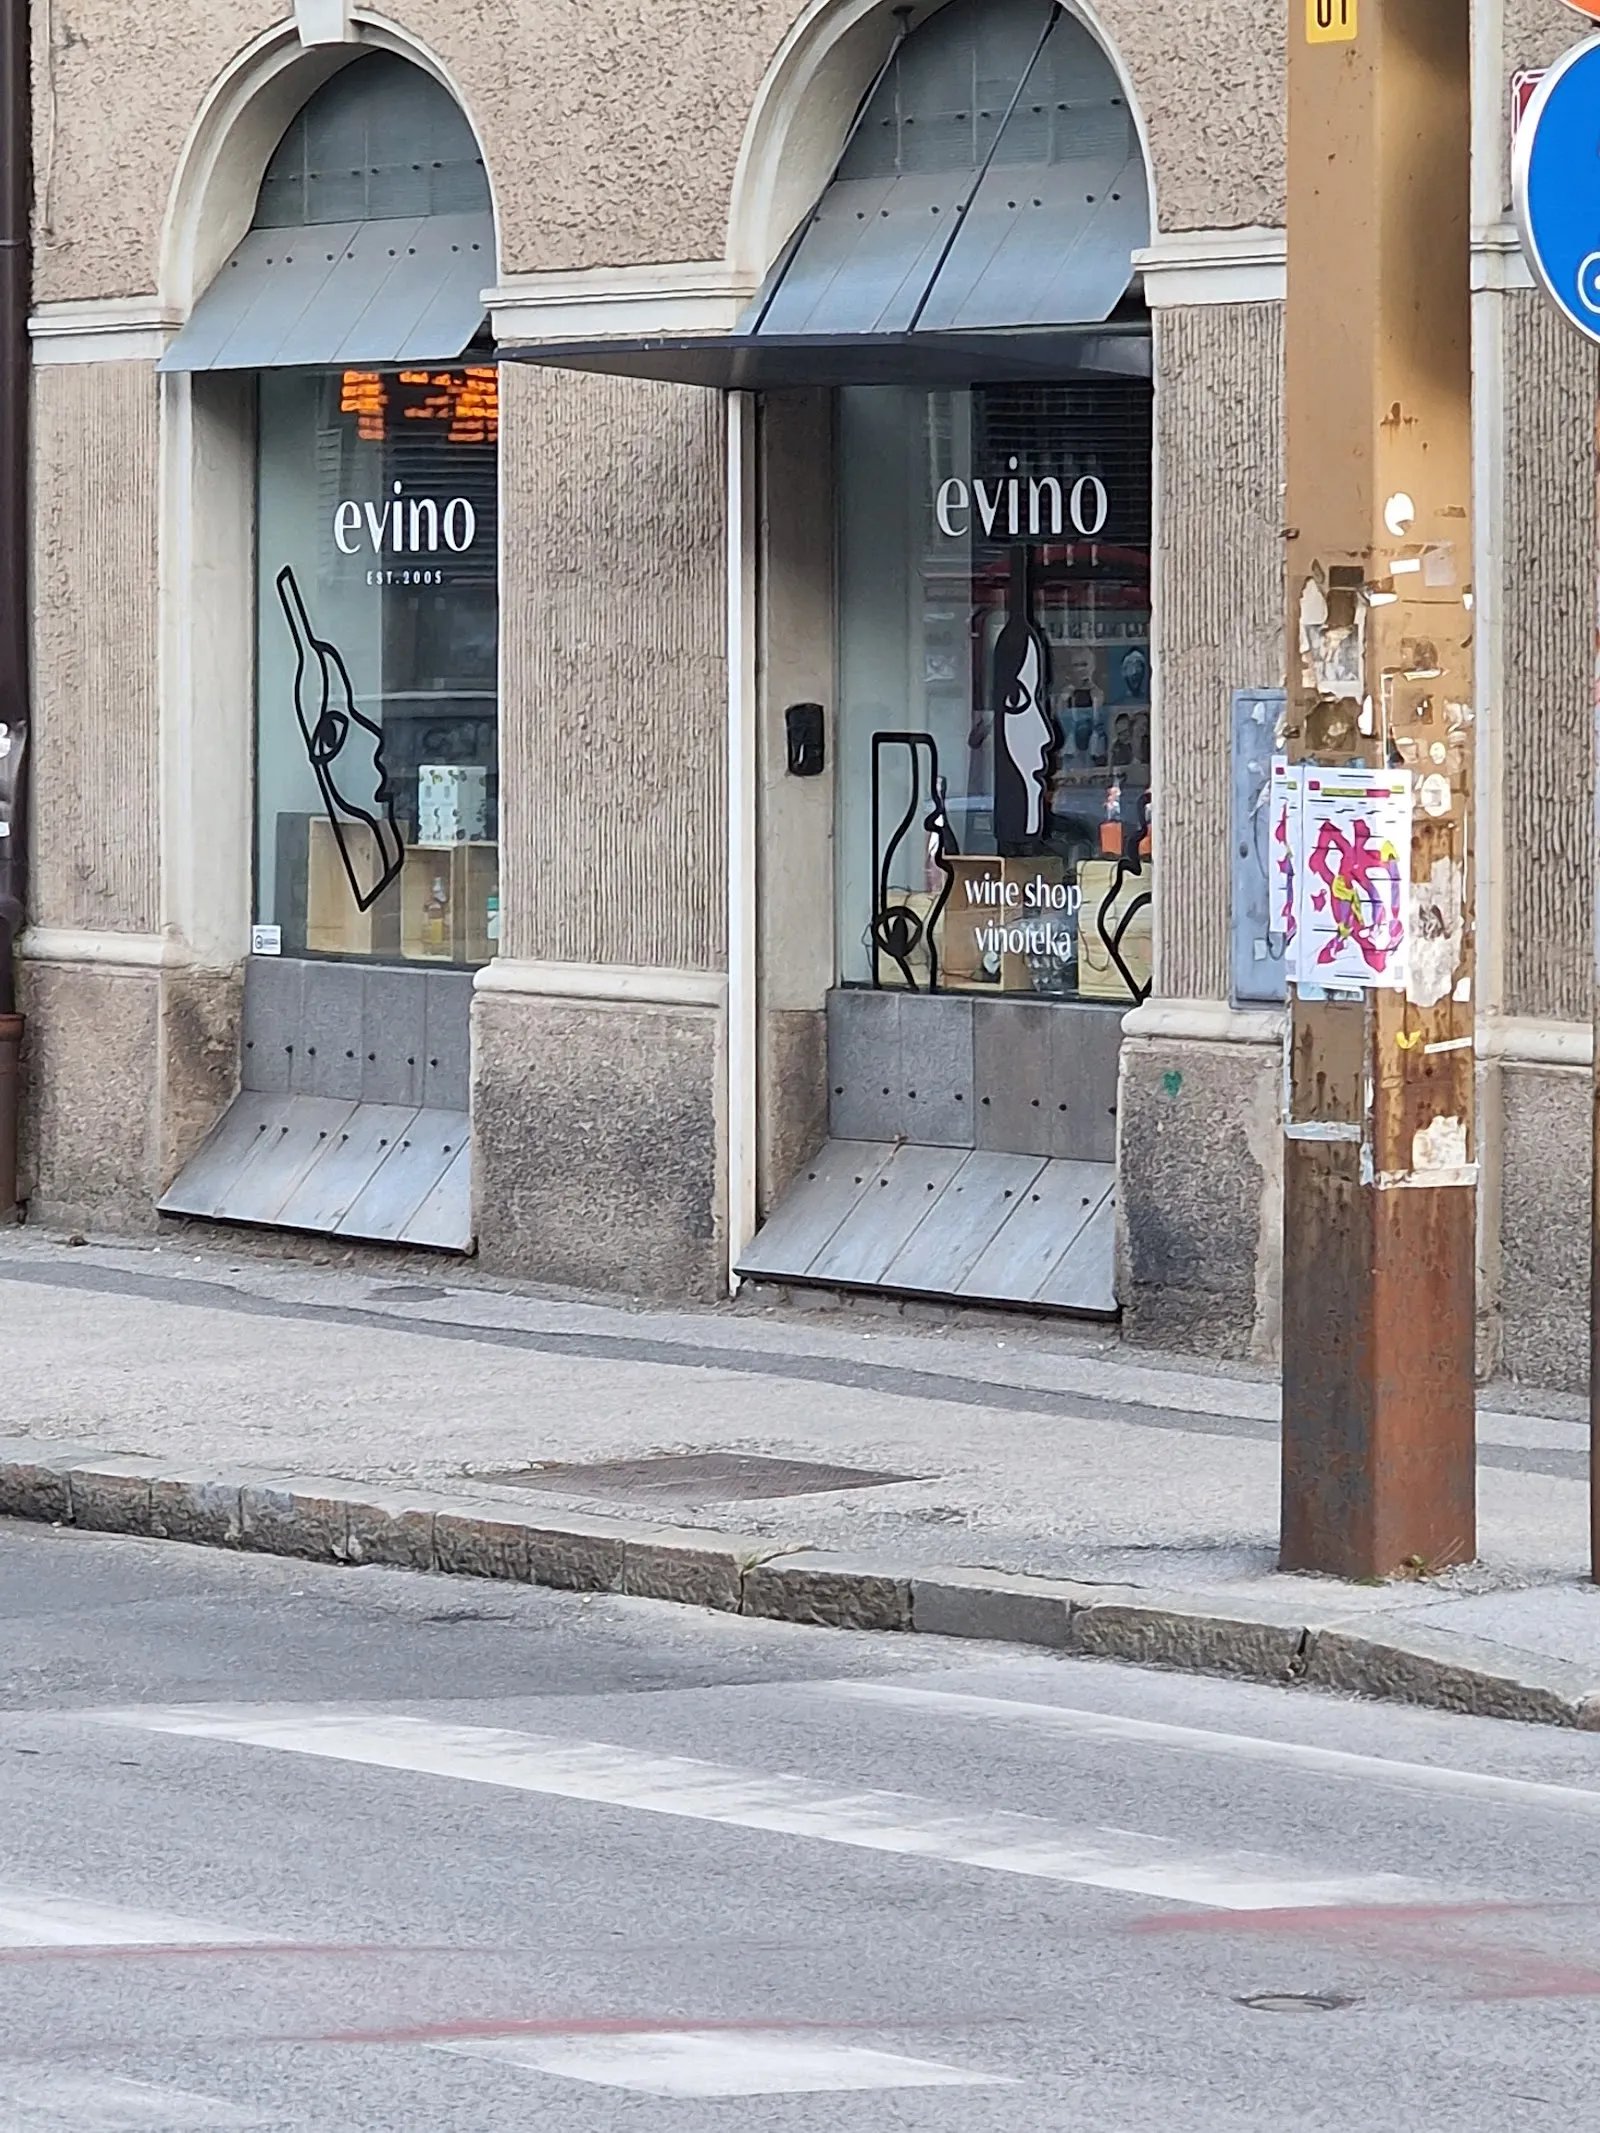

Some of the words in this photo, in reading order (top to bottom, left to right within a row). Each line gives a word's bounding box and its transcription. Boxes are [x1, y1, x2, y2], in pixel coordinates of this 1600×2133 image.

[334, 480, 476, 554] evino
[936, 456, 1108, 537] evino
[964, 872, 1020, 907] wine
[1024, 874, 1082, 916] shop
[974, 919, 1072, 956] vinoteka
